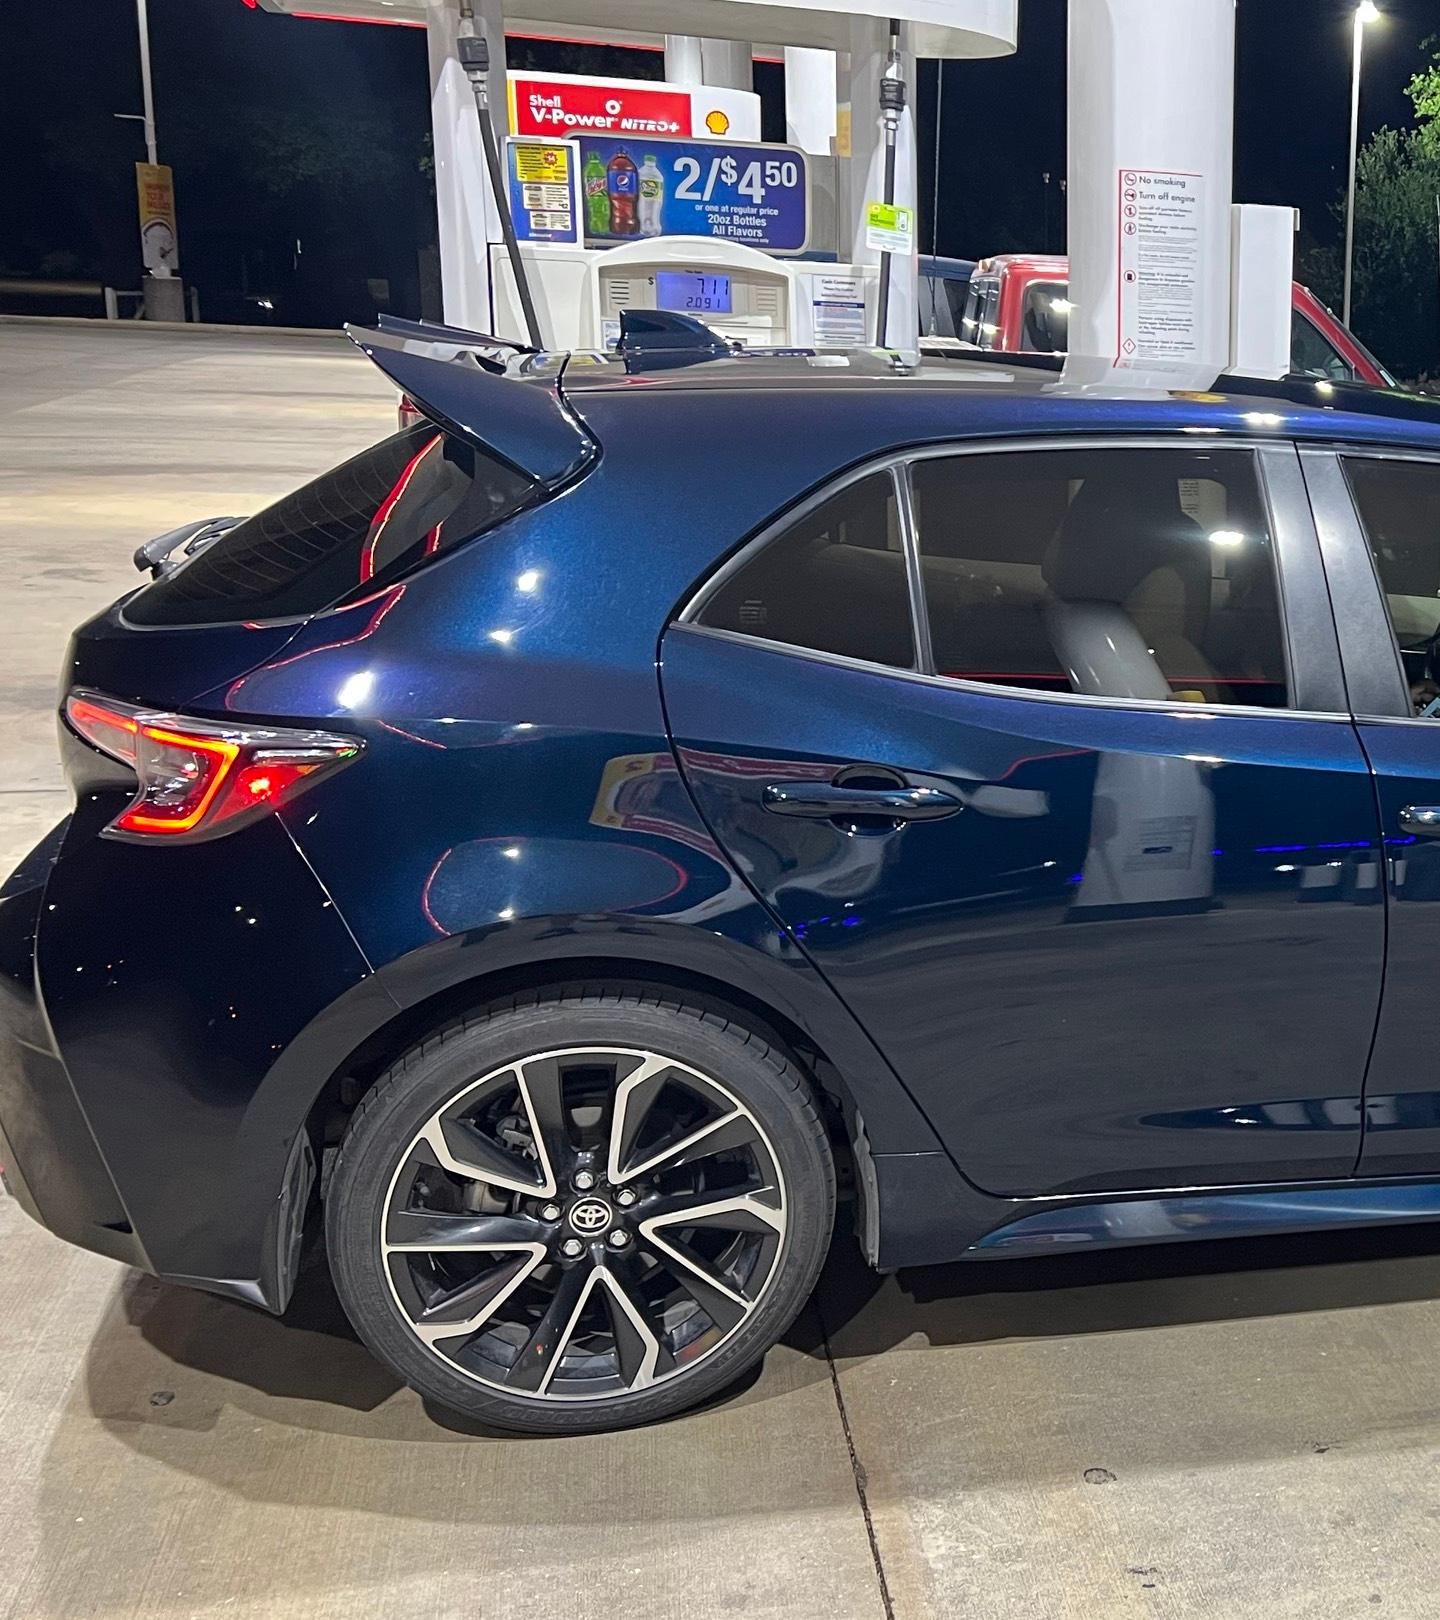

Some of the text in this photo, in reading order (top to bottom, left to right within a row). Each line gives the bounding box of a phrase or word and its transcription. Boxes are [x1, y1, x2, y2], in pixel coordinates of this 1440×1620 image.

[529, 94, 561, 108] Shell
[529, 107, 616, 128] V-Power
[1139, 176, 1186, 188] No smoking
[1139, 191, 1196, 204] Turn off engine
[720, 205, 729, 213] at
[730, 206, 757, 216] regular
[759, 207, 779, 216] price
[707, 214, 767, 227] 20oz Bottles
[712, 224, 763, 237] All Flavors
